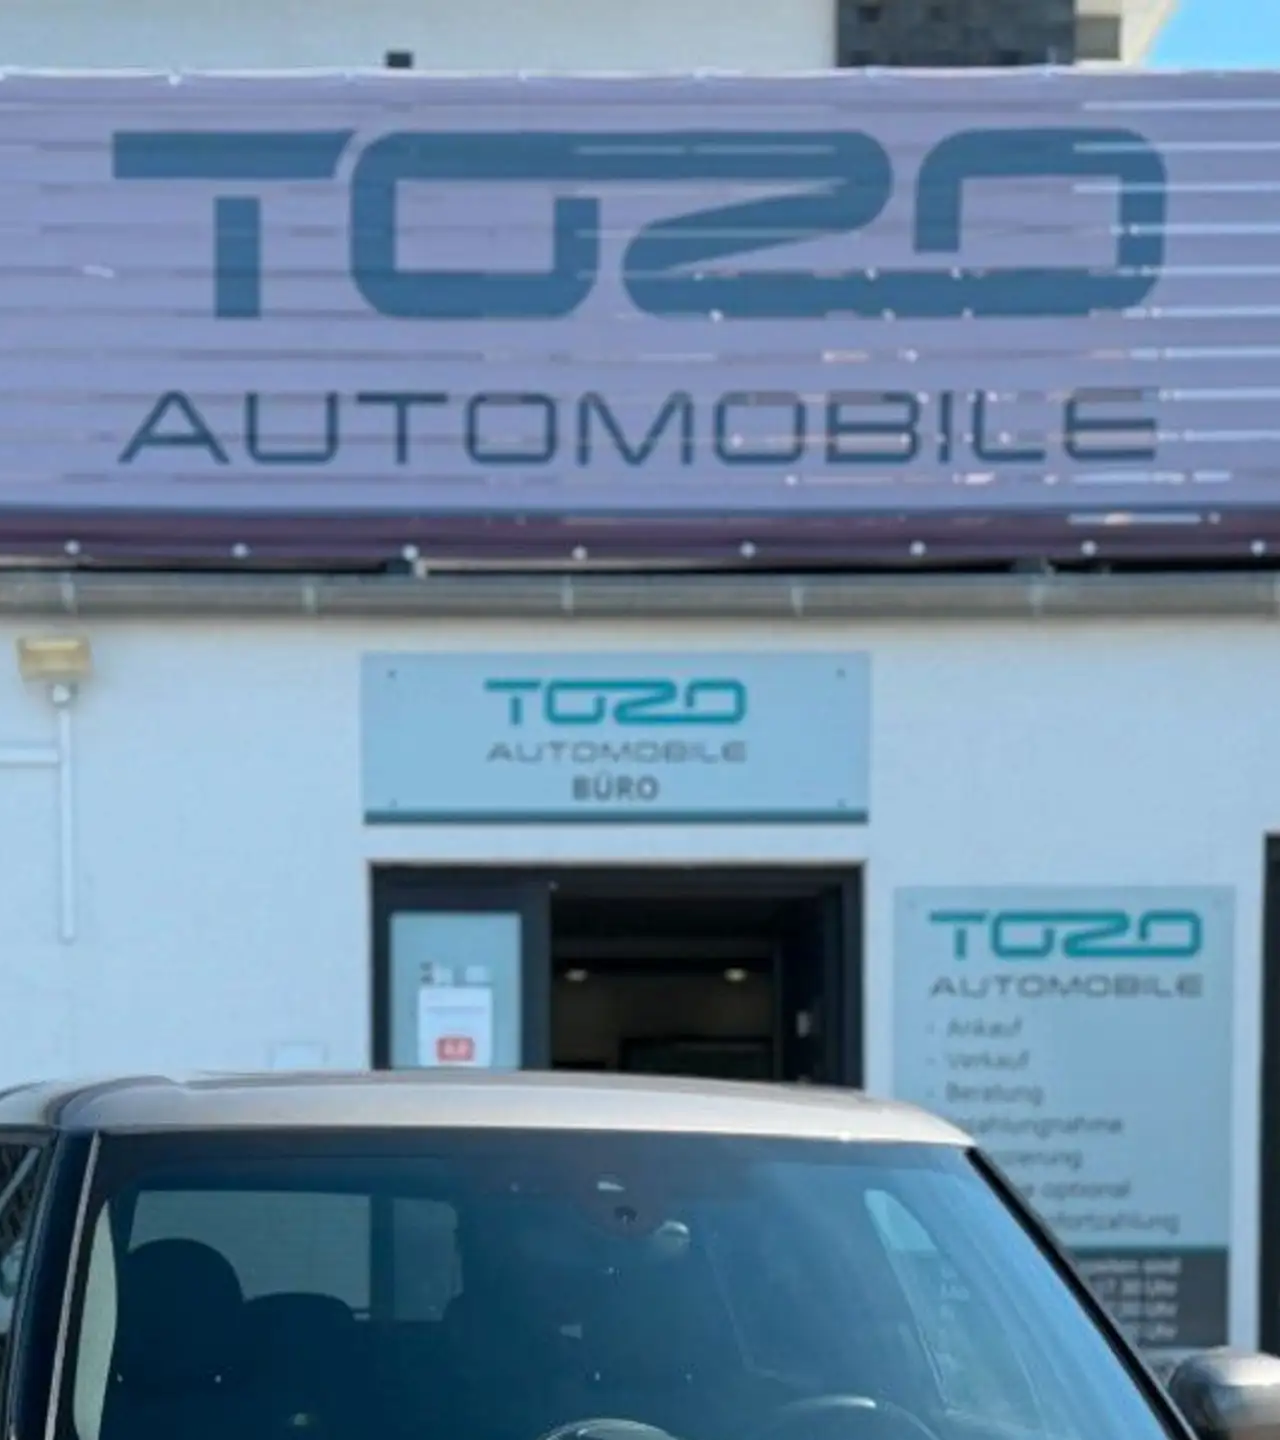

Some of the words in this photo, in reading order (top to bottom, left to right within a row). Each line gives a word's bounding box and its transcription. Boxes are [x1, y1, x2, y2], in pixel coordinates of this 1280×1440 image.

[112, 129, 1167, 319] TOZO
[119, 388, 1158, 466] AUTOMOBILE
[484, 678, 747, 726] TOZO
[486, 741, 748, 764] AUTOMOBILE
[572, 772, 660, 802] BÜRO
[929, 911, 1203, 960] TOZO
[929, 974, 1204, 1000] AUTOMOBILE
